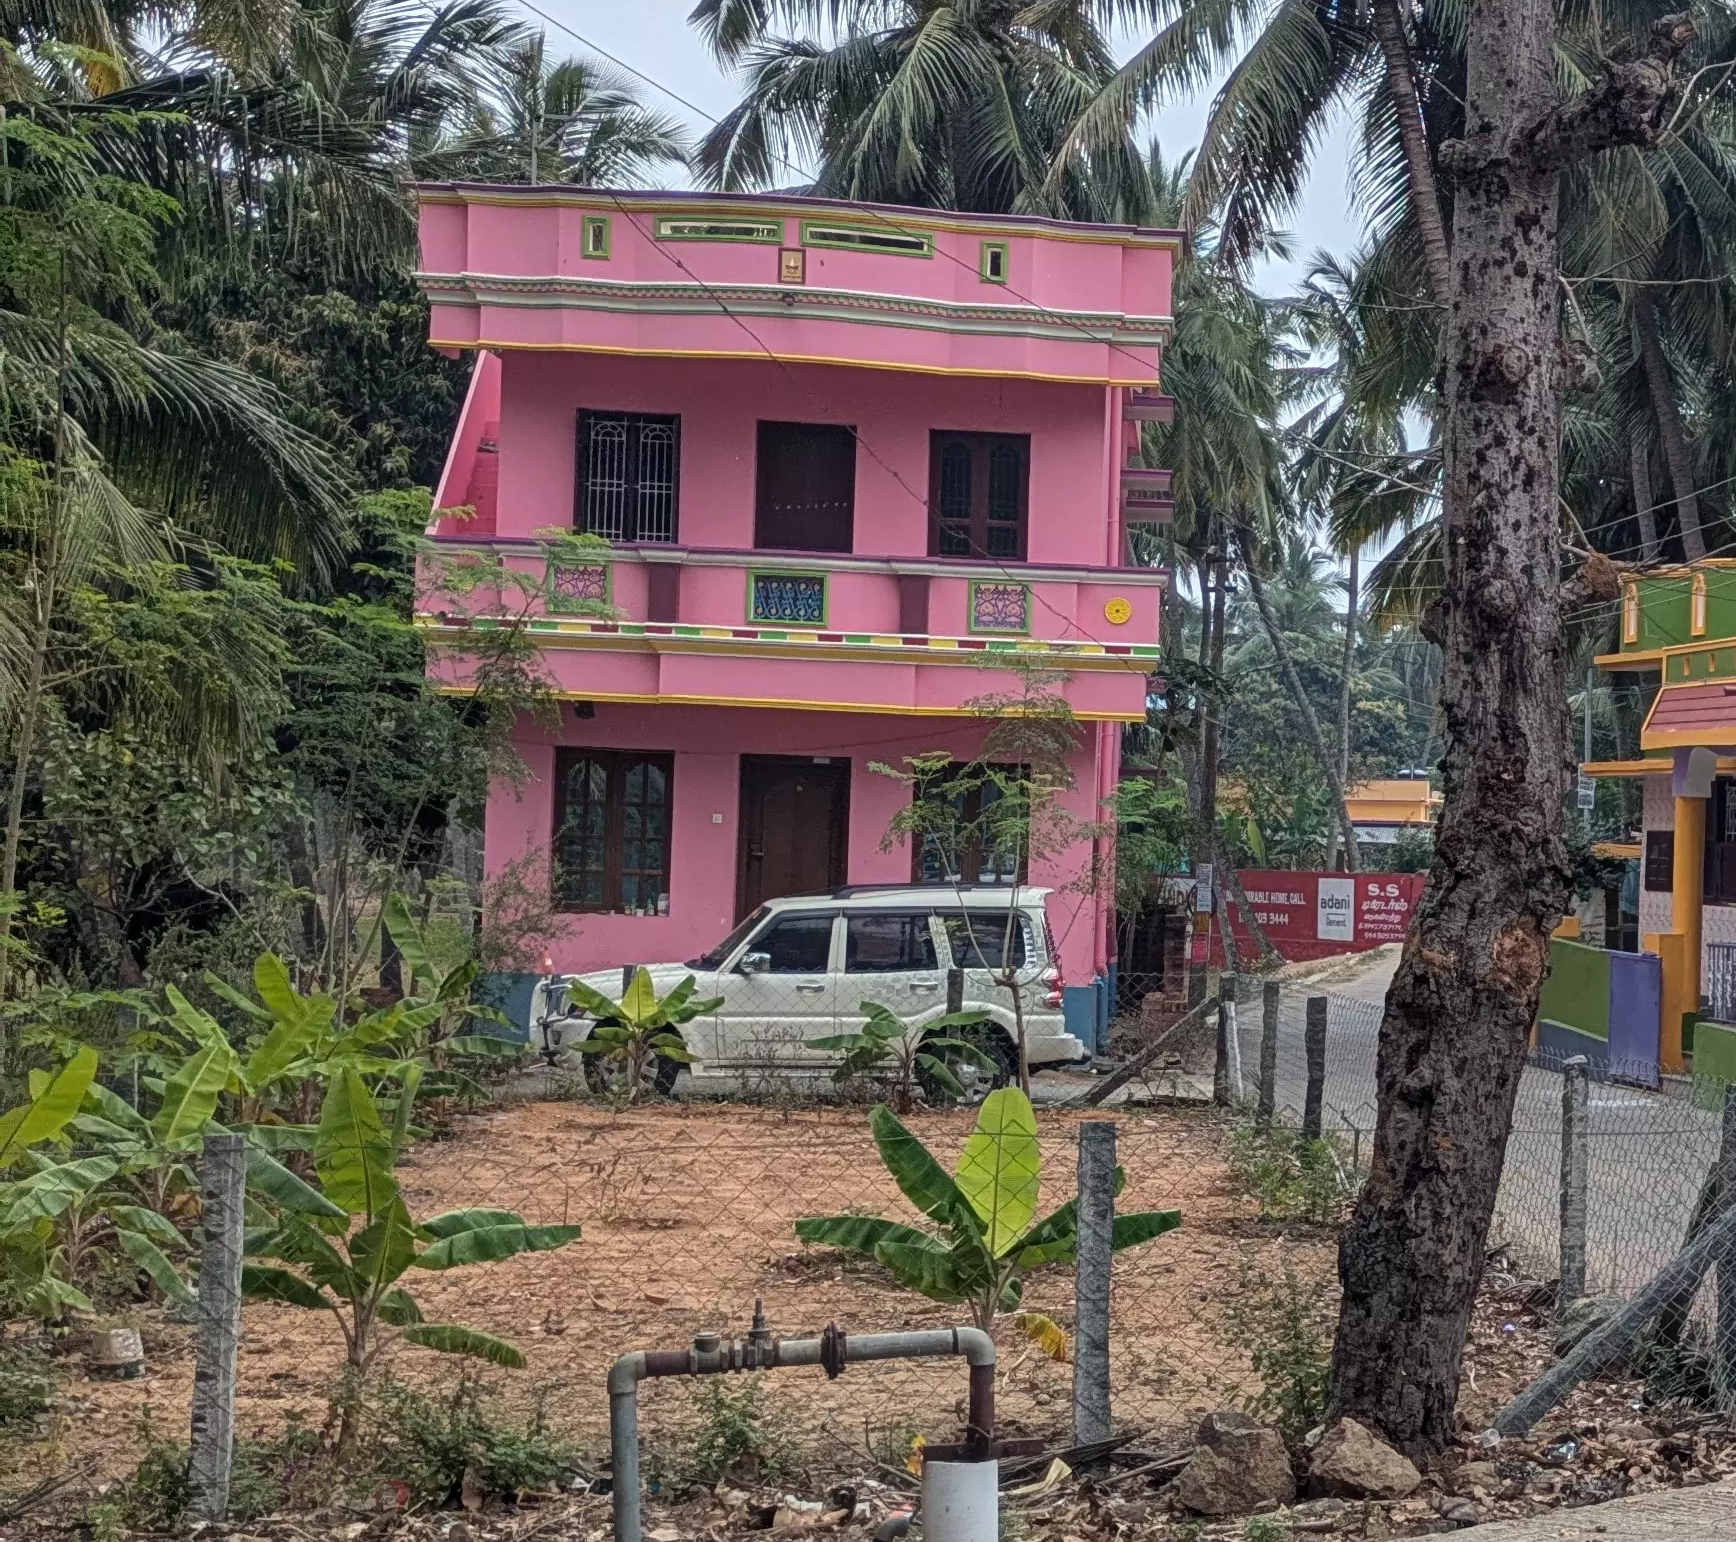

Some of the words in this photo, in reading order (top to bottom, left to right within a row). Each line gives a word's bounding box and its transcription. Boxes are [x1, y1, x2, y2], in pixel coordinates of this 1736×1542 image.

[1367, 883, 1400, 897] S.S
[1271, 892, 1290, 905] HOME
[1290, 893, 1307, 905] CALL
[1321, 894, 1350, 910] adani
[1269, 913, 1289, 925] 3444
